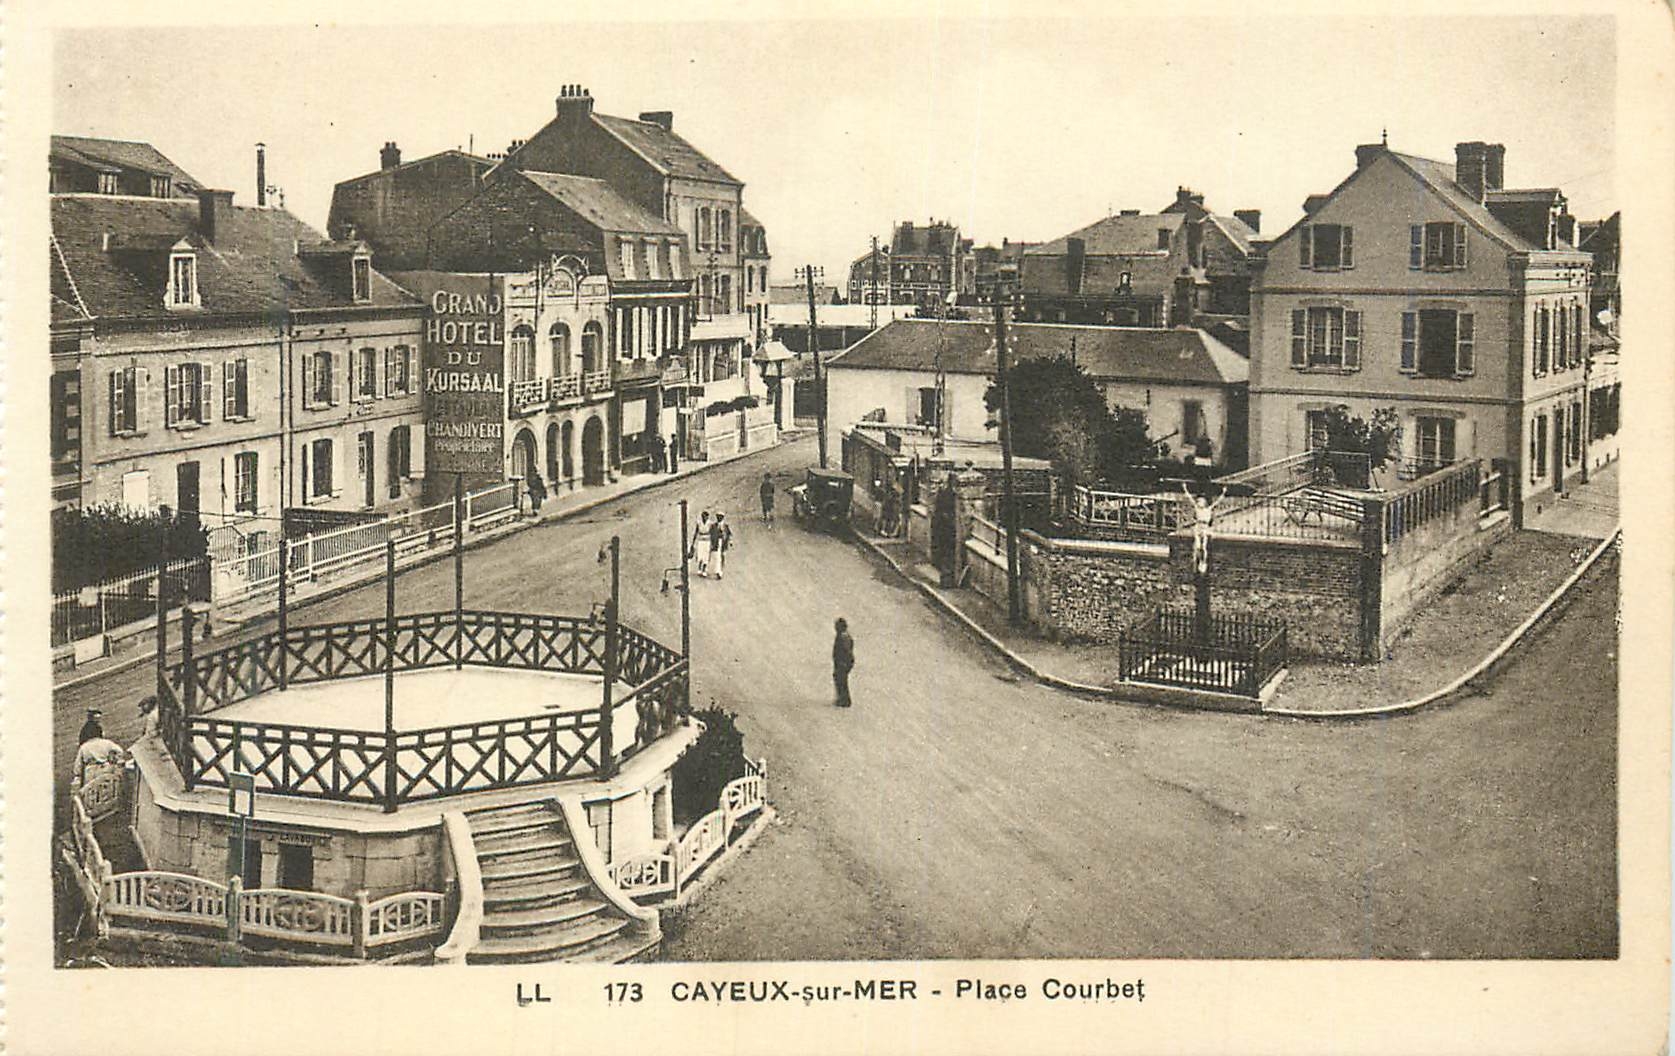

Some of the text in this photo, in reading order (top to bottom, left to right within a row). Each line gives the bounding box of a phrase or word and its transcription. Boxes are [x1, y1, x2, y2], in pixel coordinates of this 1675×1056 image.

[432, 290, 501, 315] GRAND
[427, 319, 504, 345] HOTEL
[447, 351, 482, 365] DU
[425, 368, 504, 393] KURSAAL
[426, 419, 503, 438] CHANDIVERT
